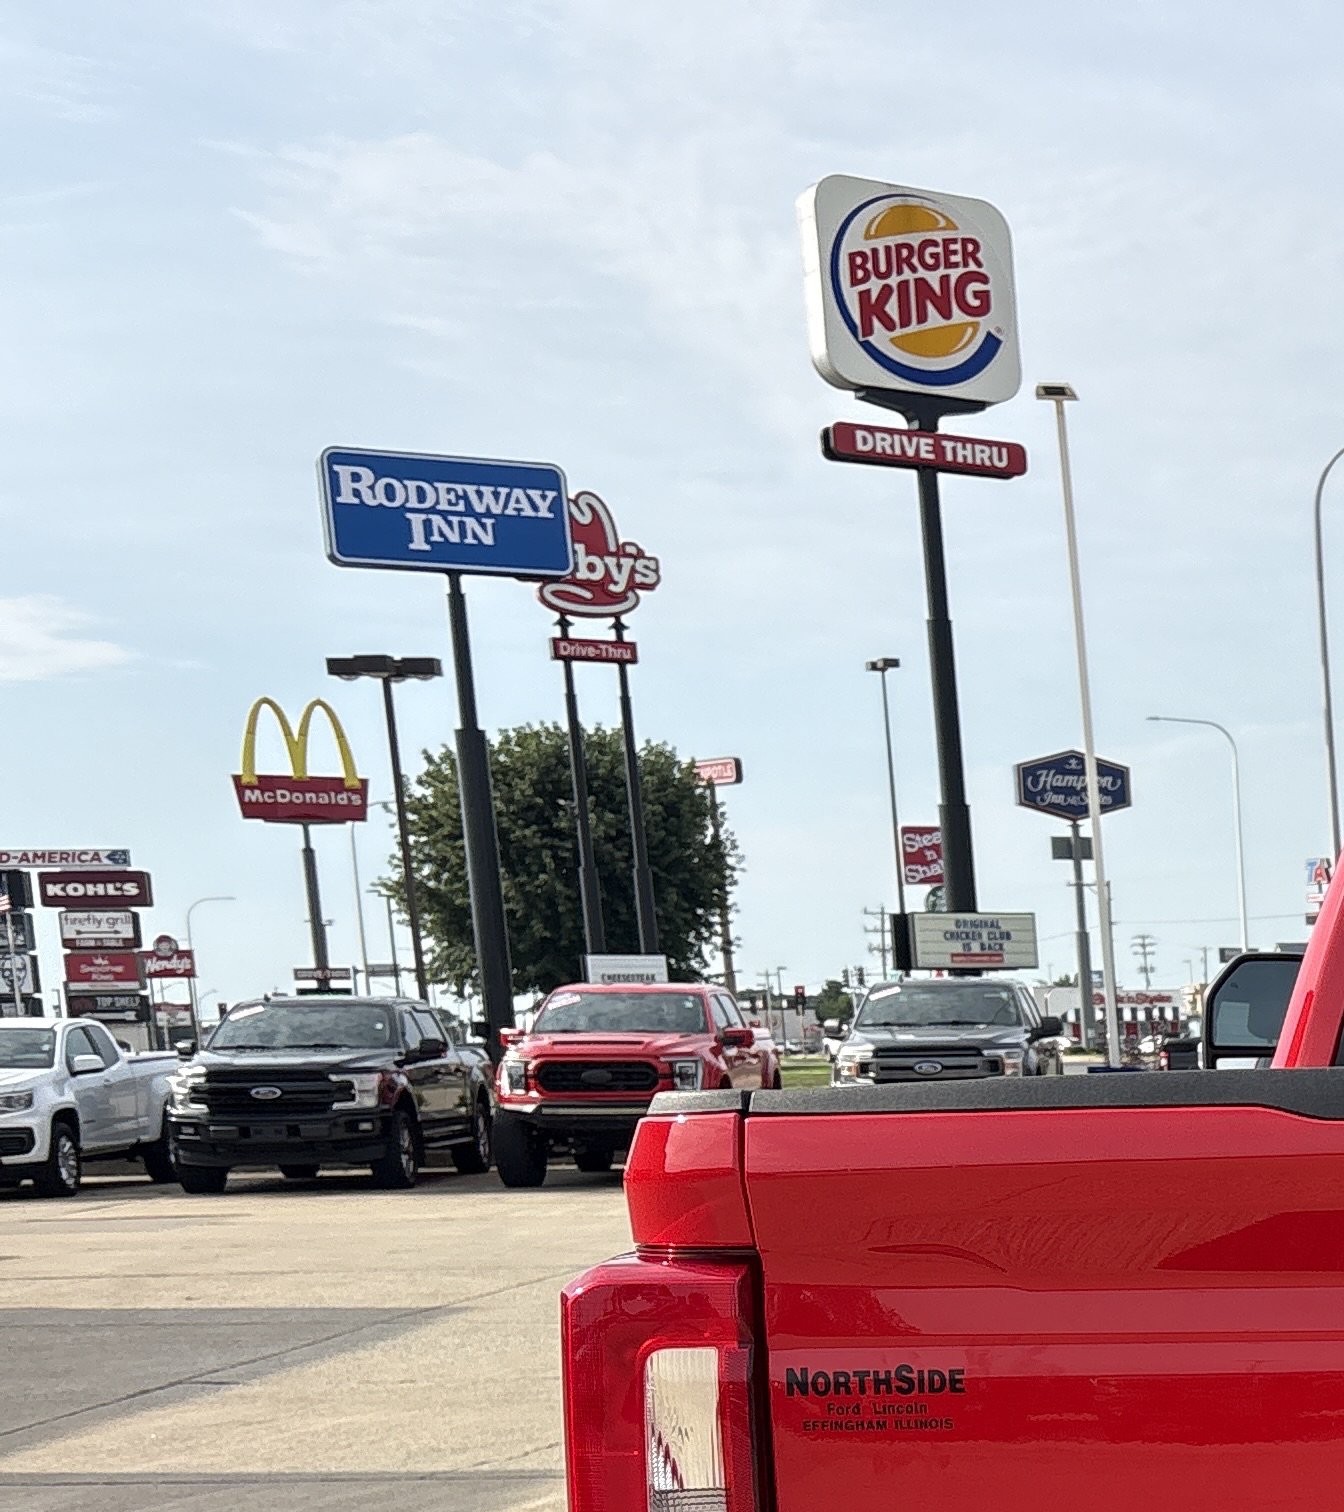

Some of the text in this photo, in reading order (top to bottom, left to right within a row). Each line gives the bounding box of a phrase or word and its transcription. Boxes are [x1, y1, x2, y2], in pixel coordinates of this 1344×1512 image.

[848, 237, 984, 287] BURGER
[857, 271, 993, 339] KING
[854, 429, 1009, 469] DRIVE THRU
[332, 463, 558, 519] RODEWAY
[405, 512, 496, 551] INN
[574, 543, 659, 593] by's
[560, 641, 632, 659] Drive-Thru
[243, 789, 362, 806] McDonald's
[903, 832, 942, 853] Stea
[45, 882, 140, 897] KOHL'S
[105, 914, 132, 929] grill
[955, 919, 1002, 929] ORIGINAL
[943, 930, 1012, 941] CHICKEN CLUB
[980, 942, 1004, 952] BACK
[144, 954, 192, 974] Wendy's
[827, 1402, 928, 1416] Ford Lincoln
[803, 1418, 954, 1432] EFFINGHAM ILLINOIS
